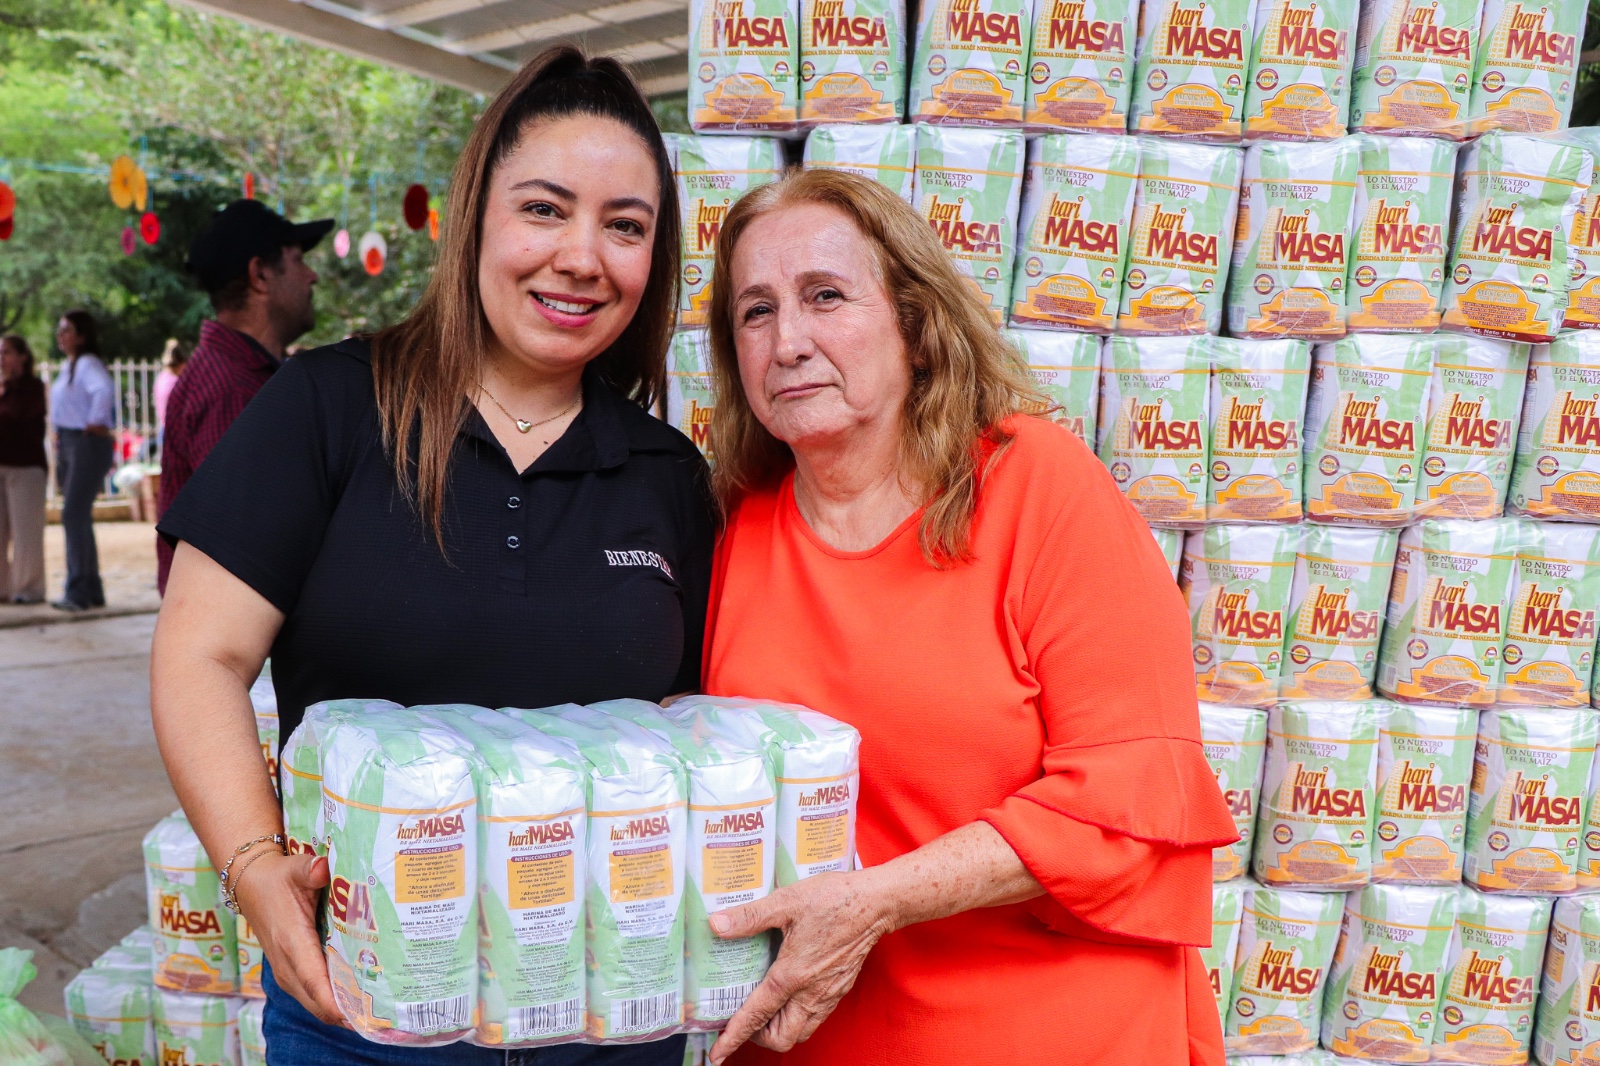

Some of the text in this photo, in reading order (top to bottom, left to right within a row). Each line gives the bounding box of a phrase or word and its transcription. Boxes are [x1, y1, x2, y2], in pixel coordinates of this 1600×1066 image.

[1054, 0, 1086, 19] hari
[1170, 2, 1206, 26] hari
[1281, 2, 1316, 26] hari
[1511, 5, 1547, 31] hari
[713, 18, 788, 47] MASA
[813, 18, 888, 47] MASA
[946, 12, 1021, 46] MASA
[1050, 19, 1124, 54] MASA
[1166, 27, 1243, 61] MASA
[1277, 28, 1348, 62] MASA
[1396, 25, 1470, 60] MASA
[1505, 30, 1576, 68] MASA
[935, 171, 972, 181] NUESTRO
[944, 180, 966, 188] MAÍZ
[1159, 181, 1196, 192] NUESTRO
[1280, 184, 1318, 192] NUESTRO
[1391, 183, 1412, 191] MAÍZ
[1491, 176, 1530, 188] NUESTRO
[1168, 189, 1189, 198] MAÍZ
[1290, 191, 1312, 199] MAÍZ
[1503, 185, 1523, 194] MAÍZ
[930, 195, 963, 220] hari
[1051, 193, 1083, 219] hari
[1152, 204, 1186, 230] hari
[1377, 200, 1410, 223] hari
[1277, 208, 1310, 233] hari
[930, 220, 1001, 255] MASA
[1044, 217, 1118, 255] MASA
[1146, 229, 1217, 266] MASA
[1273, 232, 1344, 264] MASA
[1374, 224, 1443, 254] MASA
[1472, 223, 1553, 262] MASA
[1339, 369, 1389, 380] LO NUESTRO
[1132, 398, 1162, 420] hari
[1230, 398, 1263, 420] hari
[1345, 393, 1380, 418] hari
[1451, 394, 1484, 418] hari
[1562, 392, 1599, 415] hari
[1131, 421, 1202, 449] MASA
[1228, 421, 1298, 449] MASA
[1342, 417, 1414, 451] MASA
[1446, 417, 1511, 449] MASA
[1558, 415, 1600, 446] MA
[1441, 555, 1478, 565] NUESTRO
[1216, 586, 1250, 609] hari
[1315, 586, 1350, 609] hari
[1434, 577, 1469, 602] hari
[1528, 584, 1563, 608] hari
[1214, 608, 1282, 639] MASA
[1312, 609, 1379, 639] MASA
[1429, 600, 1500, 634] MASA
[1523, 607, 1595, 639] MASA
[1394, 737, 1443, 747] LO NUESTRO
[1295, 764, 1328, 788] hari
[1401, 761, 1435, 785] hari
[1515, 772, 1549, 796] hari
[1292, 786, 1365, 817] MASA
[1398, 783, 1465, 812] MASA
[1509, 794, 1580, 825] MASA
[161, 908, 221, 934] MASA
[1463, 927, 1513, 941] LO NUESTRO
[1262, 942, 1296, 966] hari
[1369, 947, 1403, 971] hari
[1469, 951, 1504, 975] hari
[1364, 968, 1435, 1000] MASA
[1463, 972, 1534, 1004] MASA
